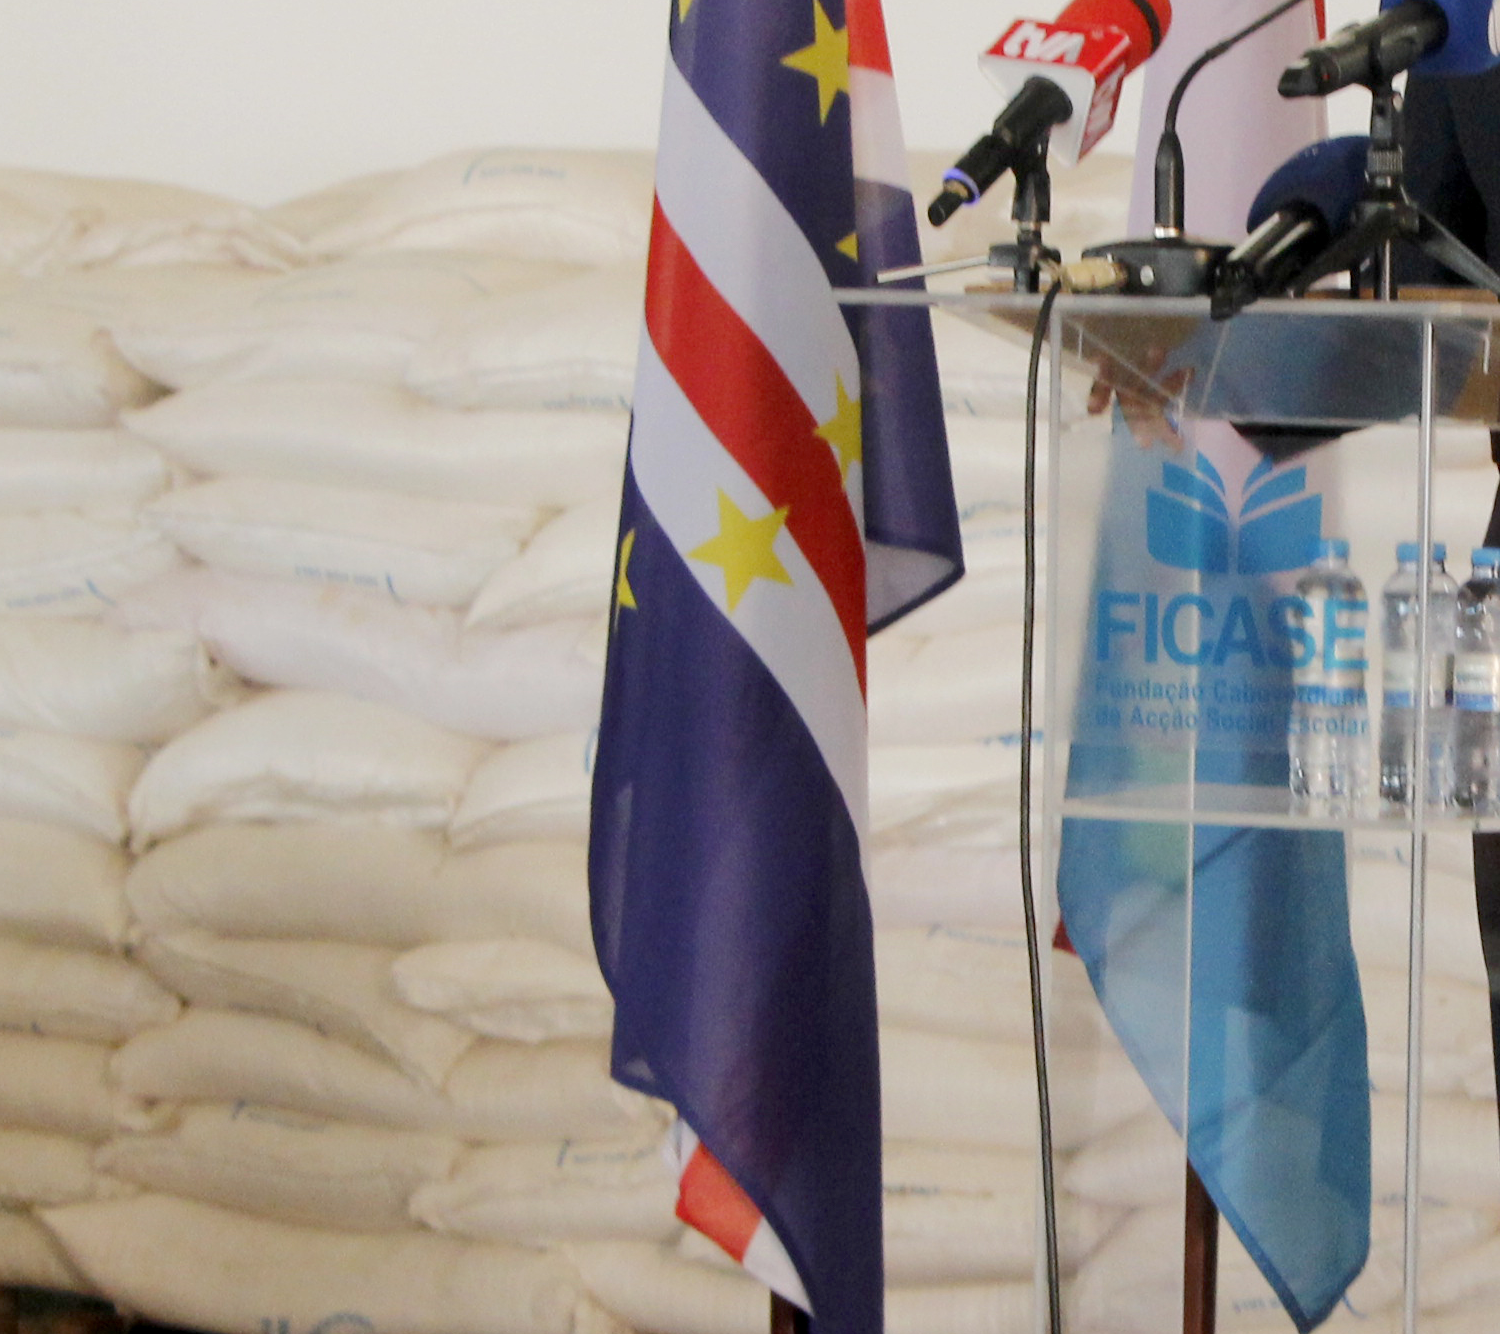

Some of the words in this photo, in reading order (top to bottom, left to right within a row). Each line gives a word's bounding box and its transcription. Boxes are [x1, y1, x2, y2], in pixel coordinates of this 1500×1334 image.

[1095, 589, 1370, 671] FICASE
[1130, 706, 1197, 734] Acção
[1286, 713, 1368, 737] Escolar
